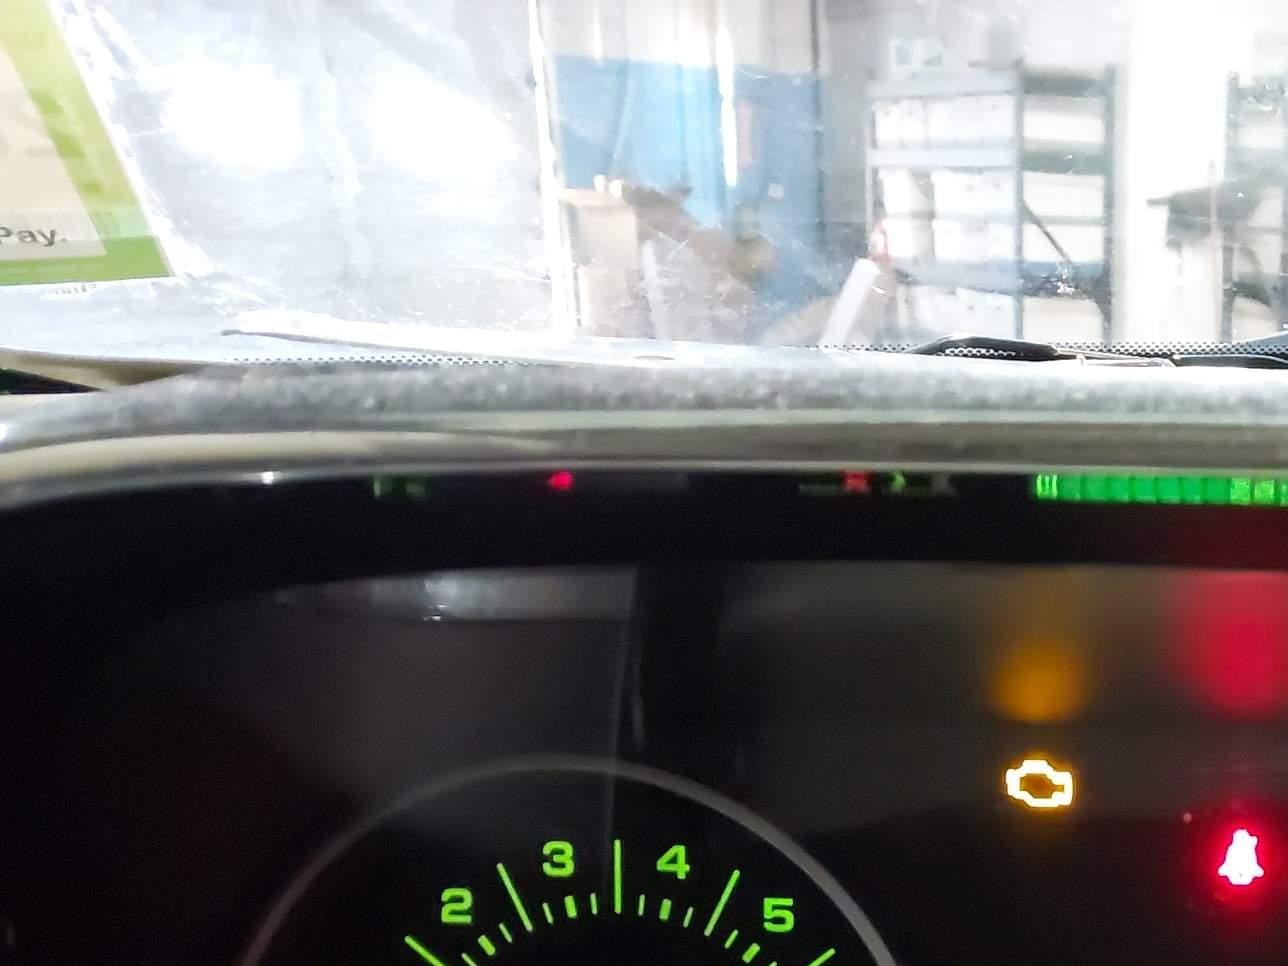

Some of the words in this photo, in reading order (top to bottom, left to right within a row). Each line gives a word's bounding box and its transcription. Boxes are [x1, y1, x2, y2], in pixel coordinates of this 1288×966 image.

[543, 841, 574, 876] 3
[657, 845, 690, 879] 4
[442, 888, 472, 923] 2
[764, 898, 794, 932] 5
